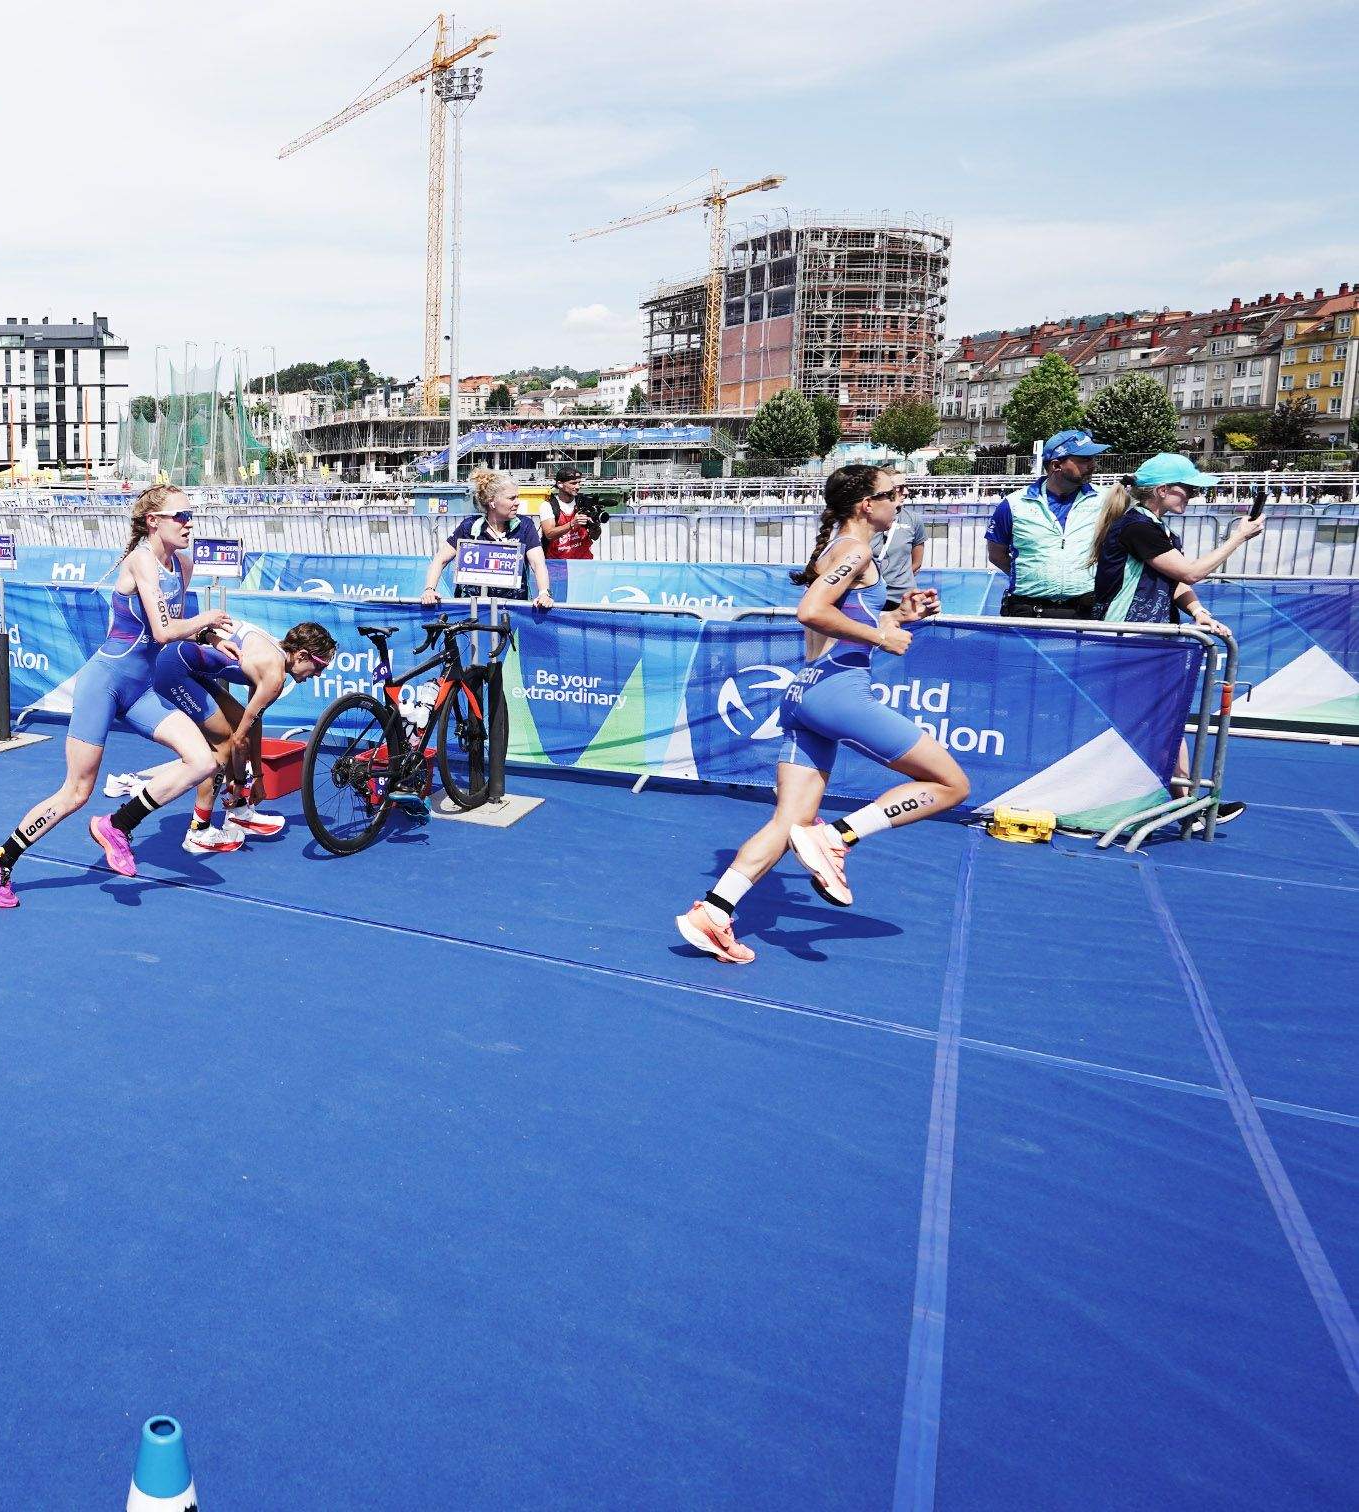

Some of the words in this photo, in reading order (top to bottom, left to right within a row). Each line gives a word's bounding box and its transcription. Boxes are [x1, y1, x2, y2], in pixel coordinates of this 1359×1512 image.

[197, 546, 210, 558] 63
[463, 551, 480, 564] 61
[489, 552, 523, 560] LEGRAND
[499, 561, 516, 569] FRA
[342, 583, 398, 598] World
[661, 592, 734, 608] World
[380, 666, 388, 675] 61
[536, 669, 559, 687] Be
[561, 674, 601, 690] your
[512, 685, 627, 710] extraordinary
[785, 685, 803, 703] FRA
[871, 680, 950, 713] orld
[883, 797, 919, 819] 89
[26, 817, 47, 836] 69
